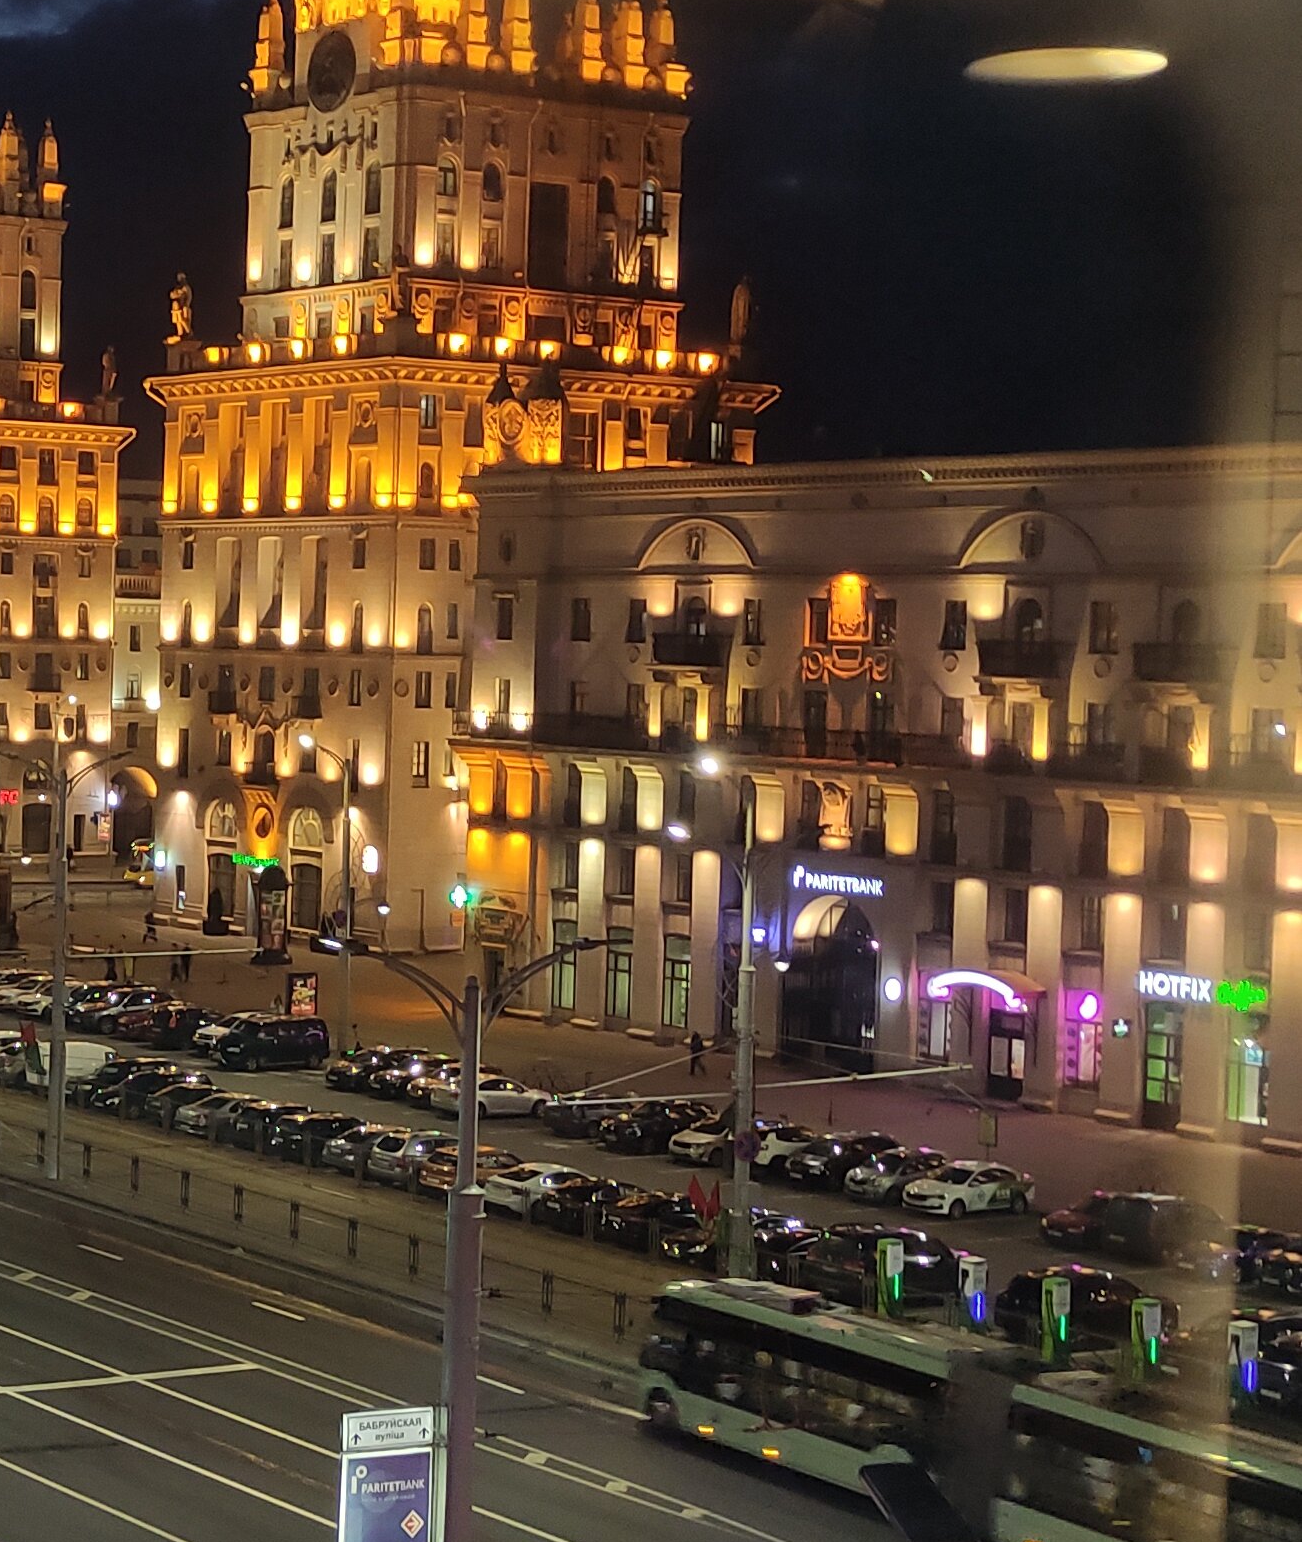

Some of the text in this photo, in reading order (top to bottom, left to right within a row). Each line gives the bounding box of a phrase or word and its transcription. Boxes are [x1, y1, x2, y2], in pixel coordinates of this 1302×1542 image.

[805, 872, 883, 896] PARITETBANK
[1139, 970, 1212, 1003] HOTFIX
[359, 1417, 421, 1431] БАБРУЙСКАЯ
[375, 1431, 405, 1442] вуліца
[361, 1479, 425, 1493] PARITETBANK
